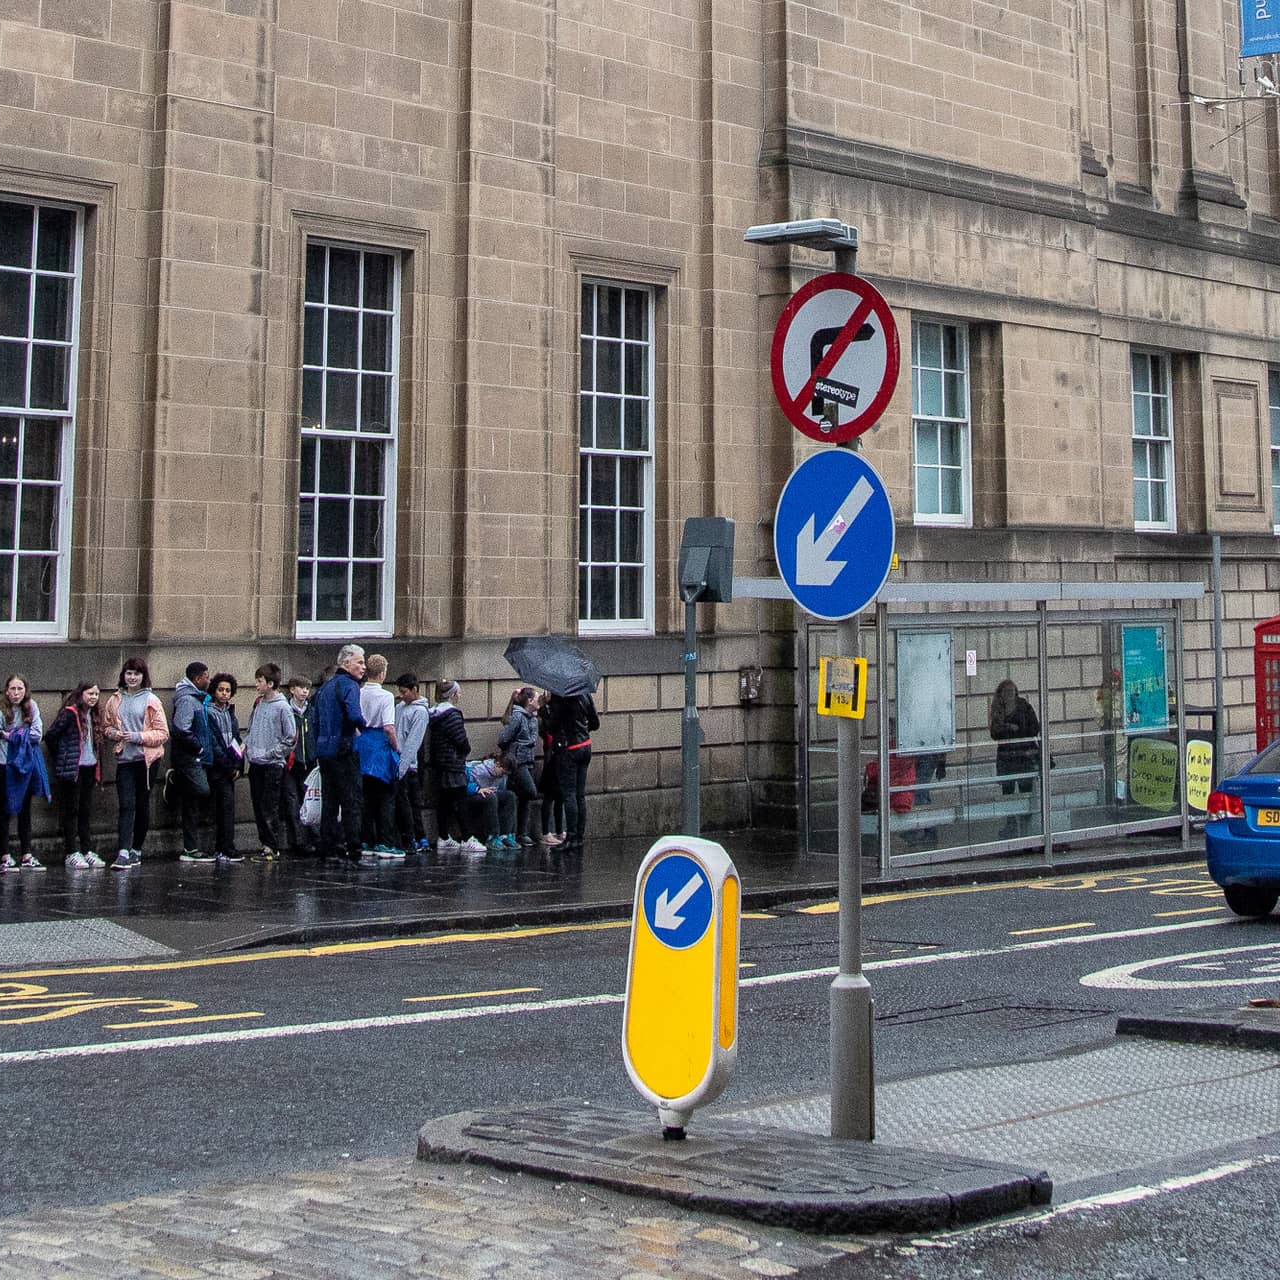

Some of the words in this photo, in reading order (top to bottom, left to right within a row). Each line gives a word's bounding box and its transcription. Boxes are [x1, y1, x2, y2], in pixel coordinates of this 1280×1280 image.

[815, 382, 857, 401] stereotype
[1151, 754, 1157, 763] a
[1162, 752, 1176, 766] bin
